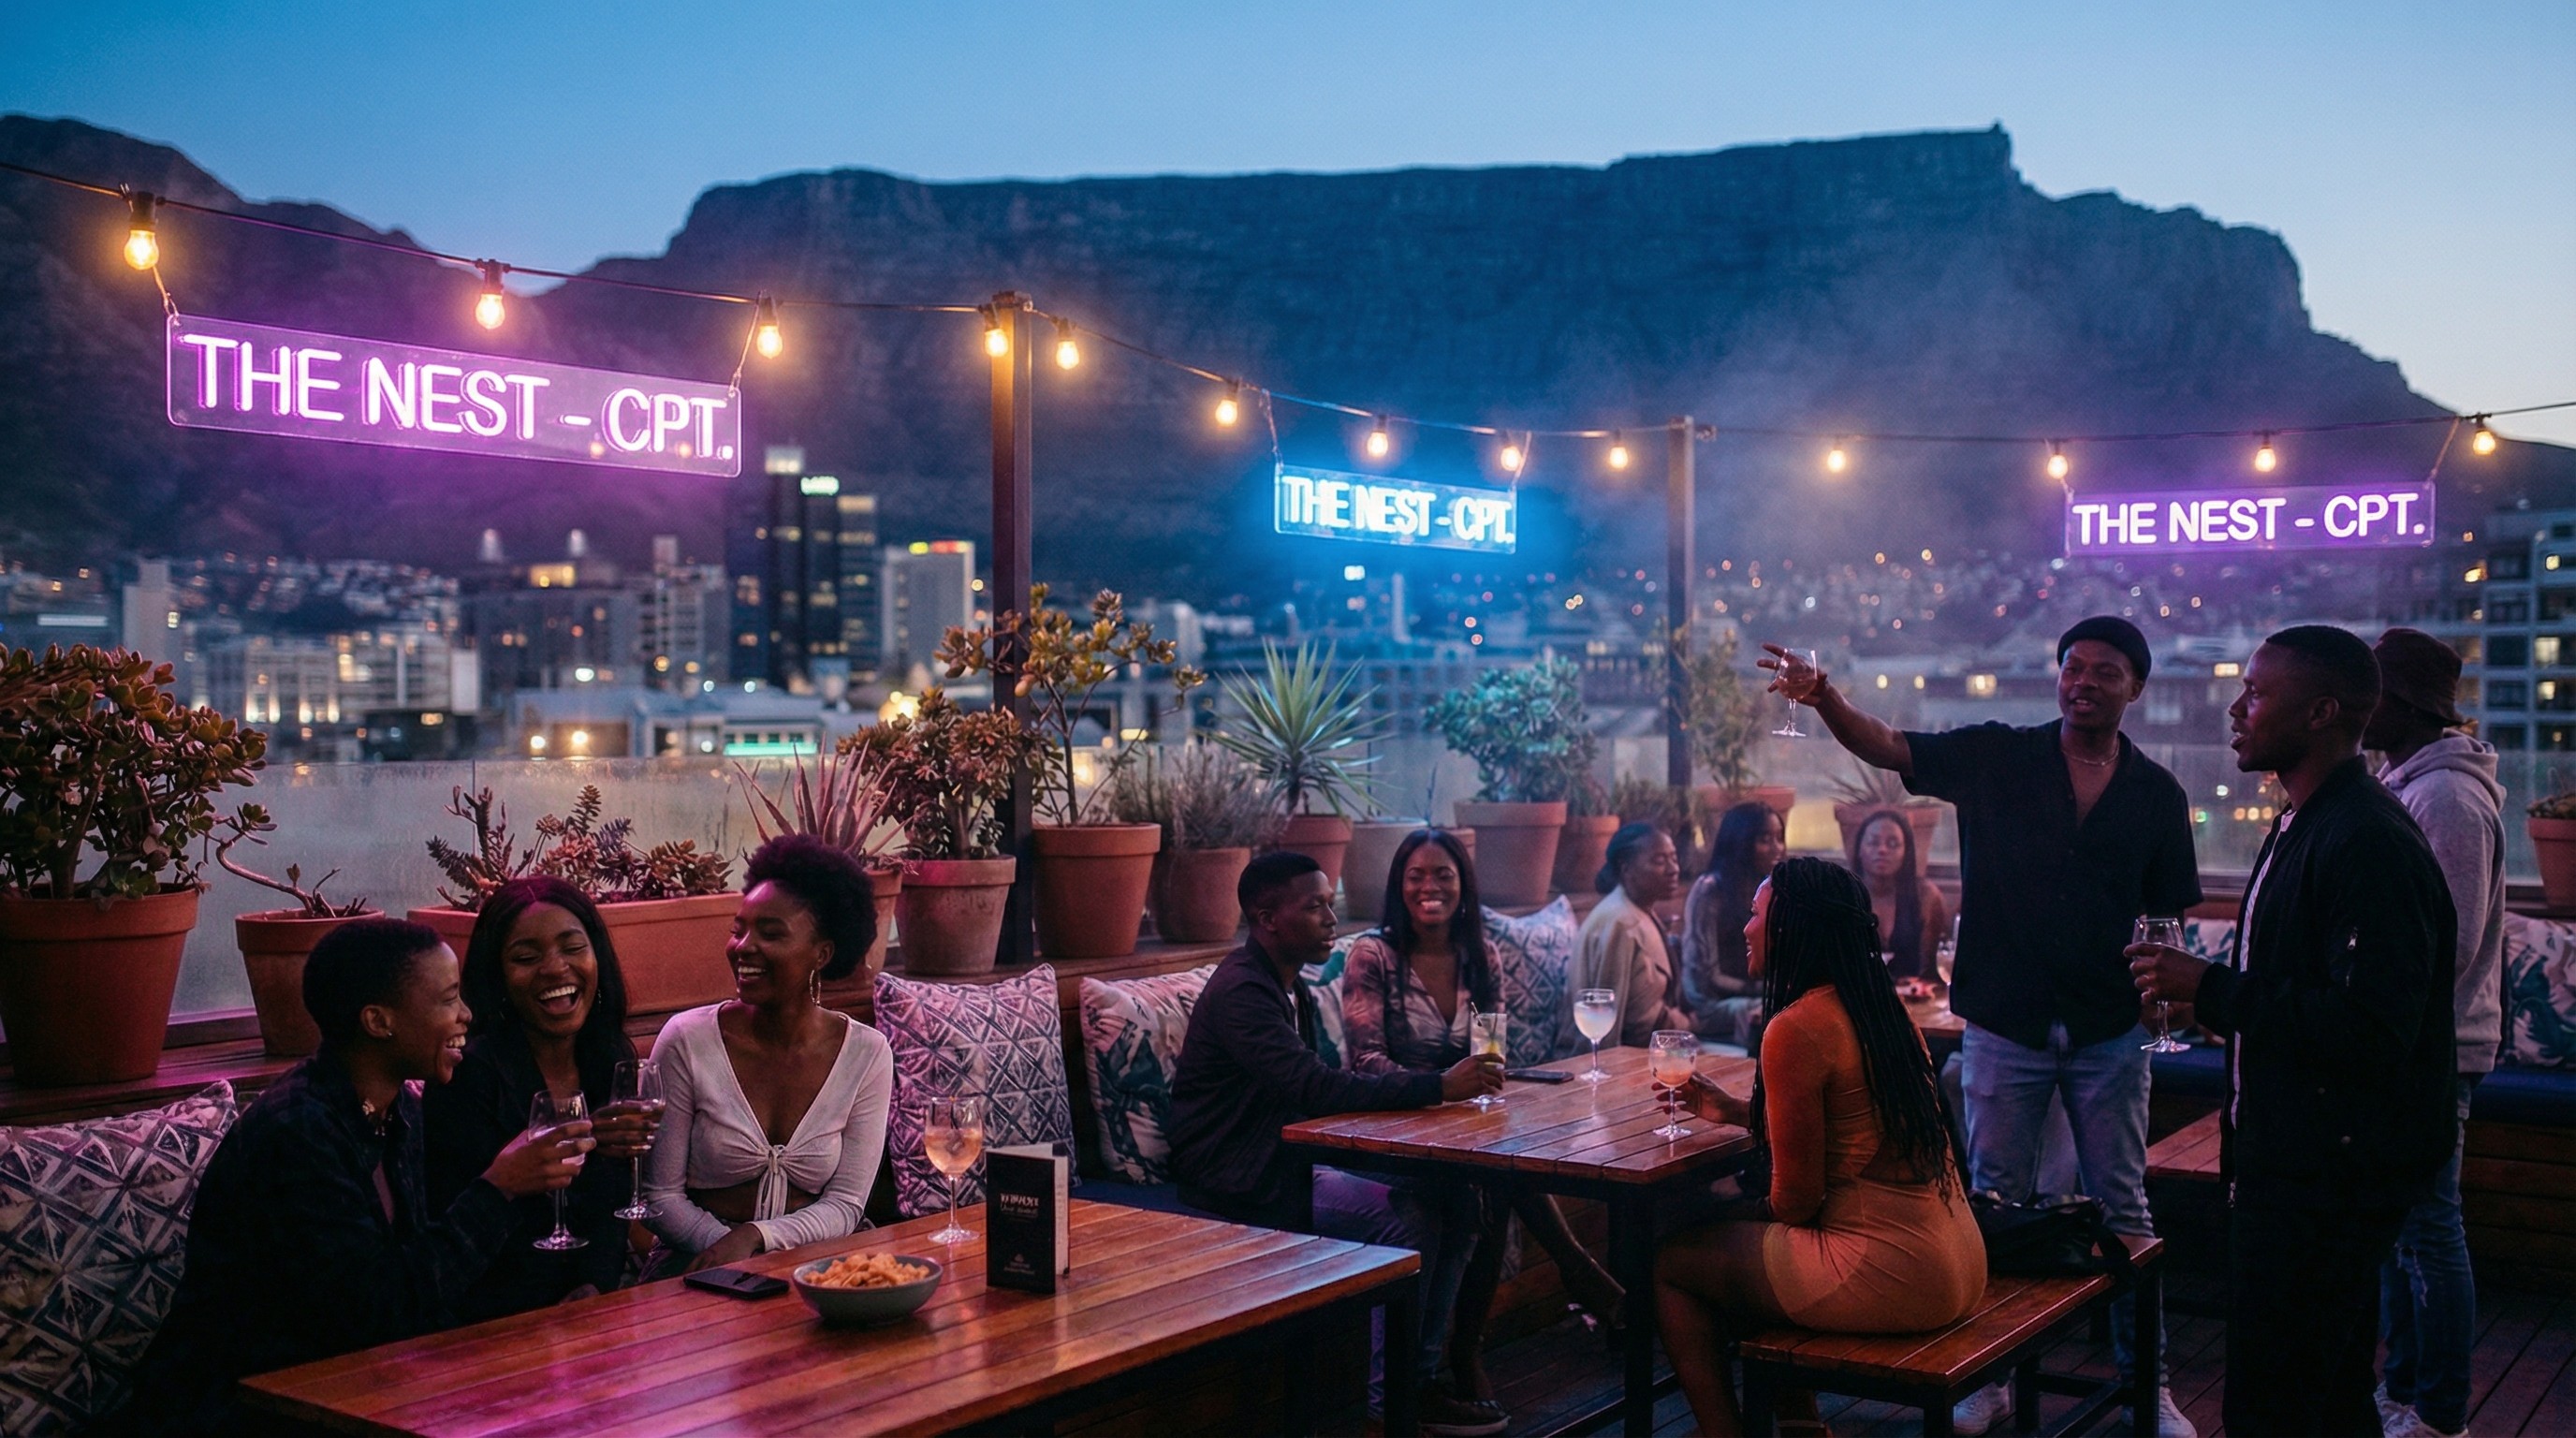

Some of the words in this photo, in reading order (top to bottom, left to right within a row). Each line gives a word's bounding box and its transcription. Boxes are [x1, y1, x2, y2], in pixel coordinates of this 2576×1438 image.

[182, 332, 344, 421] THE
[361, 356, 550, 438] NEST
[560, 414, 593, 426] -
[602, 388, 734, 459] CPT.
[1281, 476, 1350, 527] THE
[1355, 484, 1436, 536] NEST
[1453, 496, 1515, 543] CPT.
[2071, 502, 2157, 545] THE
[2169, 497, 2287, 542] NEST
[2294, 517, 2315, 527] -
[2323, 492, 2425, 537] CPT.
